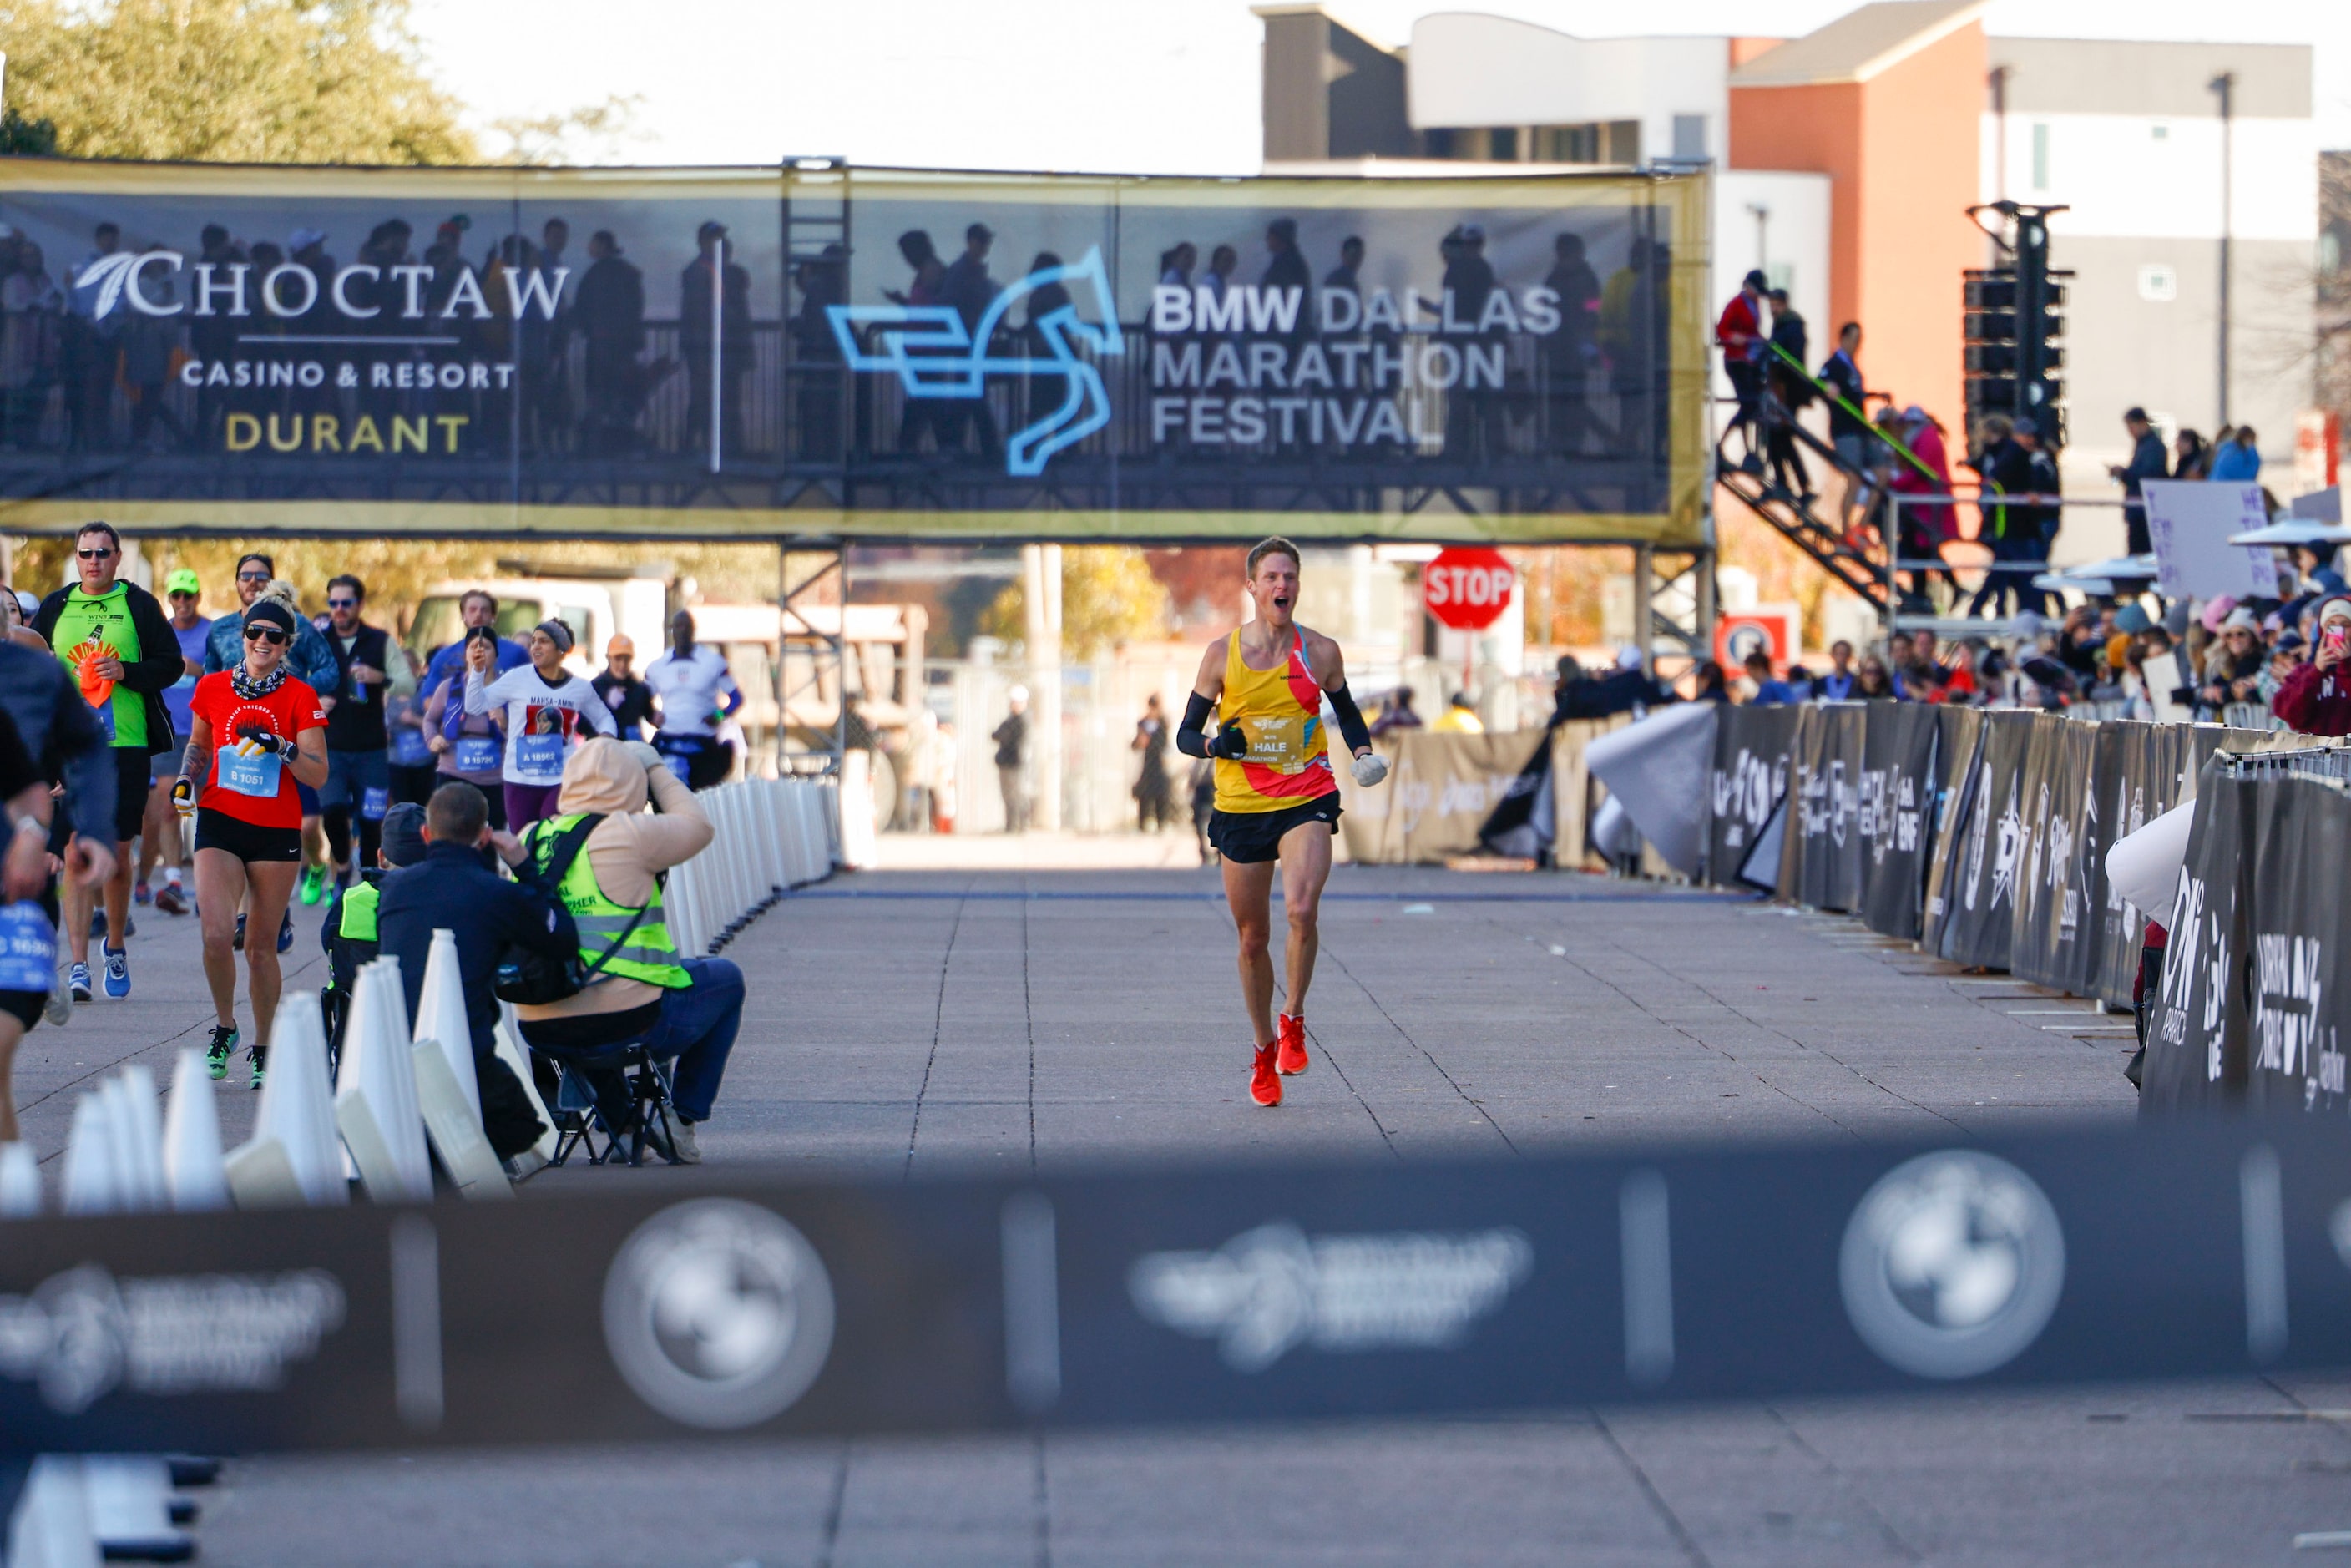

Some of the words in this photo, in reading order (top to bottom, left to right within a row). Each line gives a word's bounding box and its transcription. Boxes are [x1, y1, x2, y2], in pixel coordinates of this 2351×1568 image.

[124, 251, 570, 321] CHOCTAW
[1153, 286, 1303, 333] BMW
[1322, 286, 1563, 334] DALLAS
[181, 361, 325, 387] CASINO
[336, 361, 359, 388] &
[372, 361, 517, 390] RESORT
[1152, 341, 1505, 391] MARATHON
[225, 413, 470, 453] DURANT
[1152, 397, 1446, 447] FESTIVAL
[1428, 567, 1513, 605] STOP
[1254, 742, 1287, 752] HALE
[230, 771, 238, 781] B
[240, 773, 265, 785] 1051
